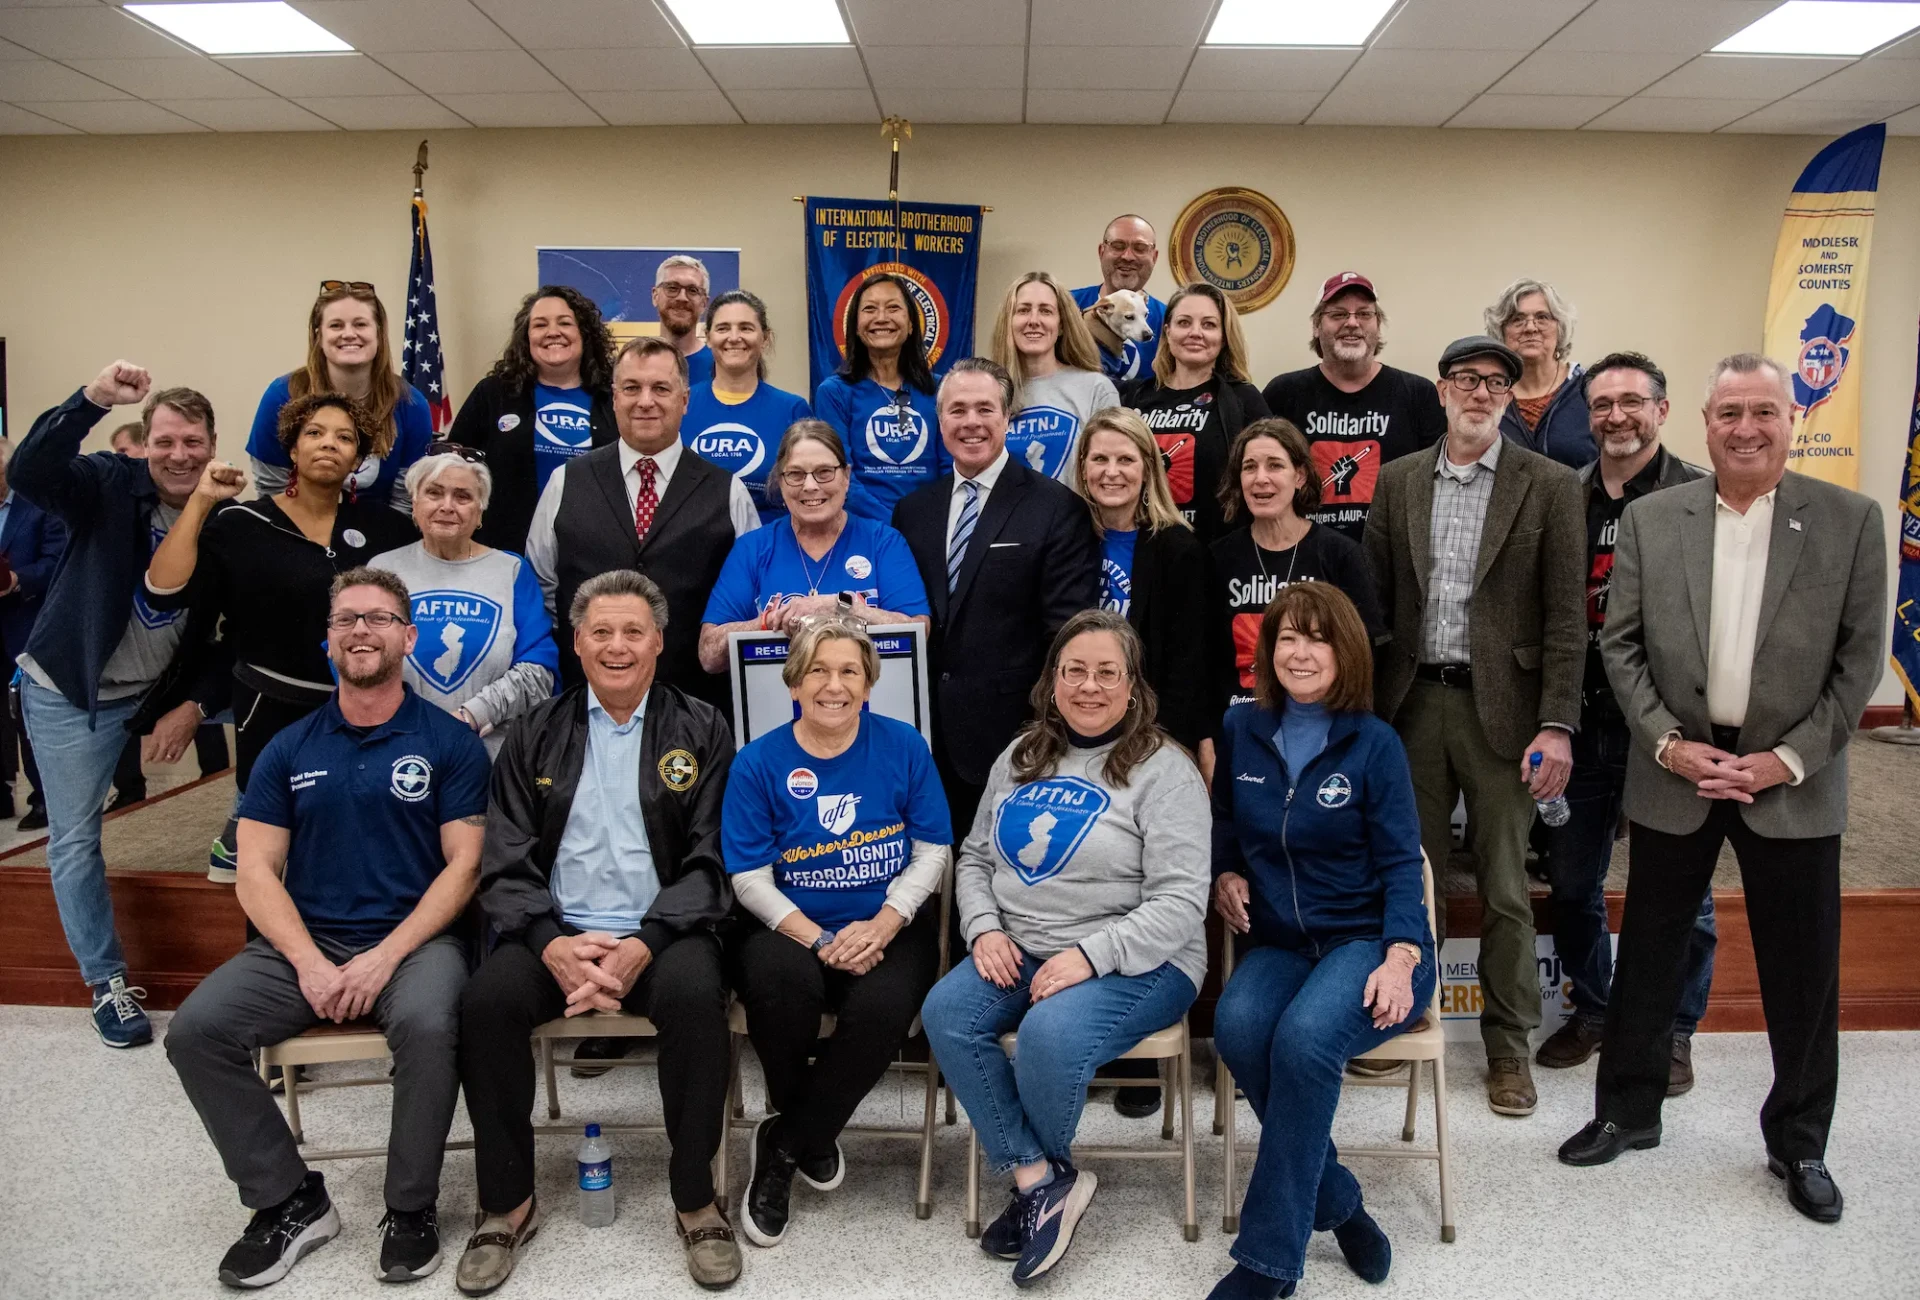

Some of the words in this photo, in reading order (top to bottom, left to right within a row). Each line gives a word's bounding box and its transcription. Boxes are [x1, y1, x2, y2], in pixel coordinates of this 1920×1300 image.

[815, 208, 895, 227] INTERNATIONAL
[901, 211, 972, 233] BROTHERHOOD
[1196, 213, 1238, 246] BROTHERHOOD
[1241, 215, 1250, 224] OF
[823, 230, 837, 247] OF
[846, 231, 907, 250] ELECTRICAL
[914, 234, 964, 254] WORKERS
[1250, 222, 1270, 261] ELECTRICAL
[1820, 251, 1838, 260] AND
[862, 263, 905, 280] AFFILIATED
[907, 267, 926, 284] WITH
[1237, 264, 1266, 286] WORKERS
[915, 290, 936, 342] ELECTRICAL
[541, 413, 591, 428] URA
[874, 420, 919, 438] URA
[1005, 415, 1059, 434] AFTNJ
[1305, 410, 1390, 437] Solidarity
[699, 438, 754, 452] URA
[1797, 433, 1831, 444] FL-CIO
[1807, 447, 1854, 457] COUNCIL
[415, 600, 481, 616] AFTNJ
[436, 615, 445, 623] of
[444, 616, 490, 624] Professionals
[755, 646, 789, 656] RE-EL
[1236, 772, 1266, 784] Laurel
[1020, 785, 1089, 806] AFTNJ
[822, 793, 862, 831] aft
[782, 839, 849, 863] Workers
[849, 822, 905, 847] Deserve
[842, 839, 904, 865] DIGNITY
[784, 855, 905, 882] AFFORDABILITY
